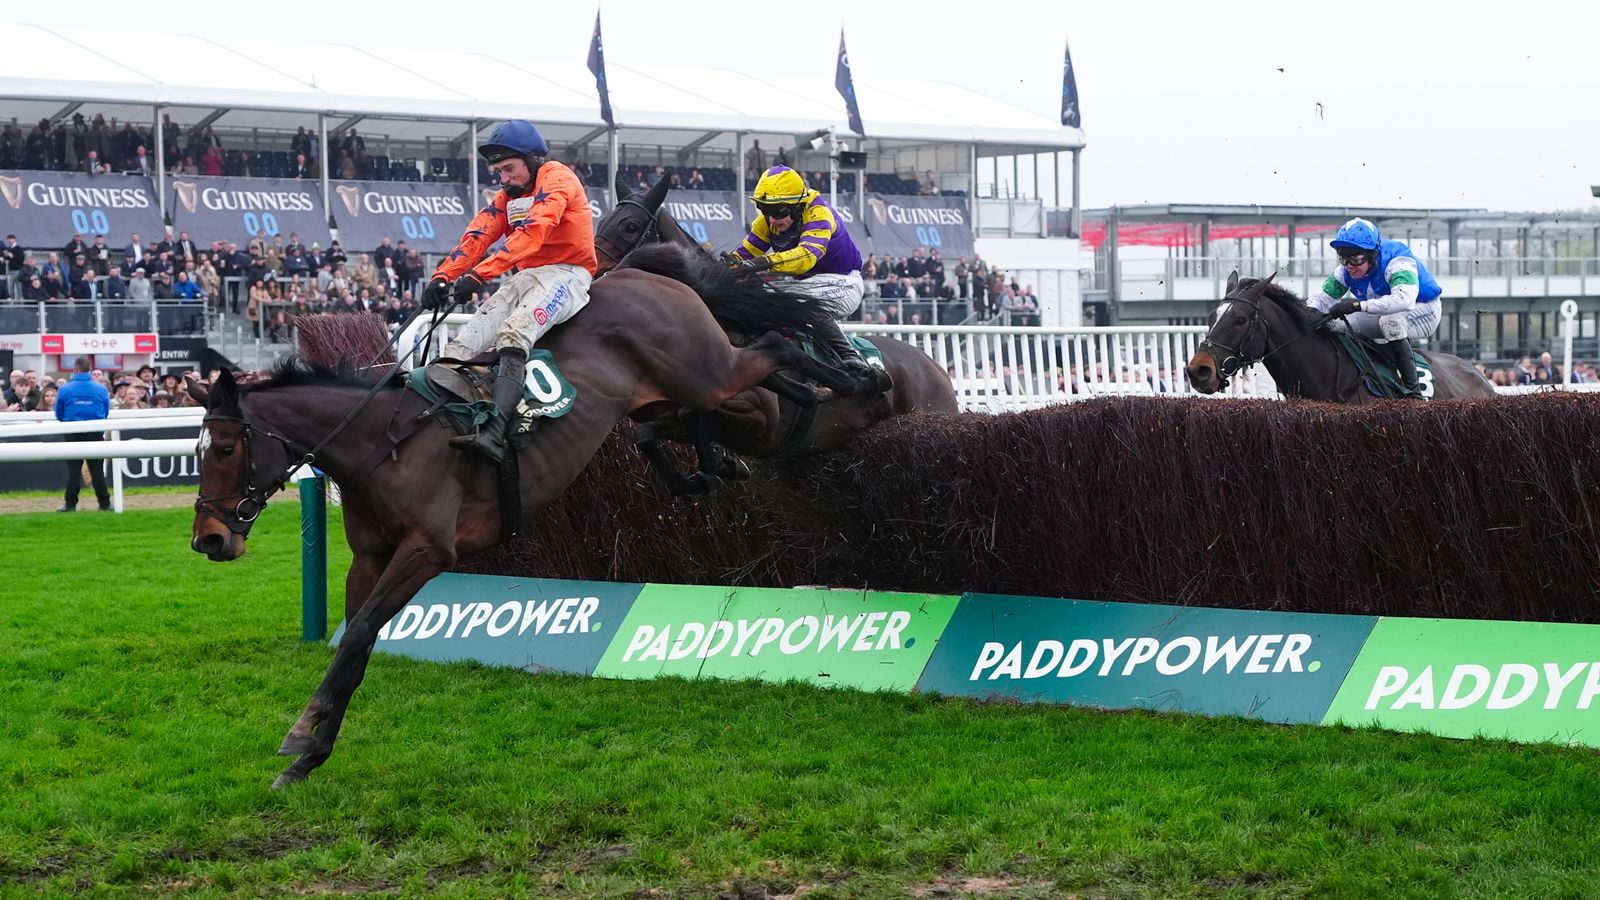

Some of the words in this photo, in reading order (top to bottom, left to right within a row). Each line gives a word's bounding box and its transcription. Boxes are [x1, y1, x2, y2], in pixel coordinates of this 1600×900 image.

[28, 183, 148, 209] GUINNESS
[202, 188, 313, 211] GUINNESS
[363, 192, 465, 215] GUINNESS
[71, 209, 110, 235] 0.0
[887, 205, 964, 225] GUINNESS
[401, 215, 435, 239] 0.0
[162, 350, 190, 359] ENTRY
